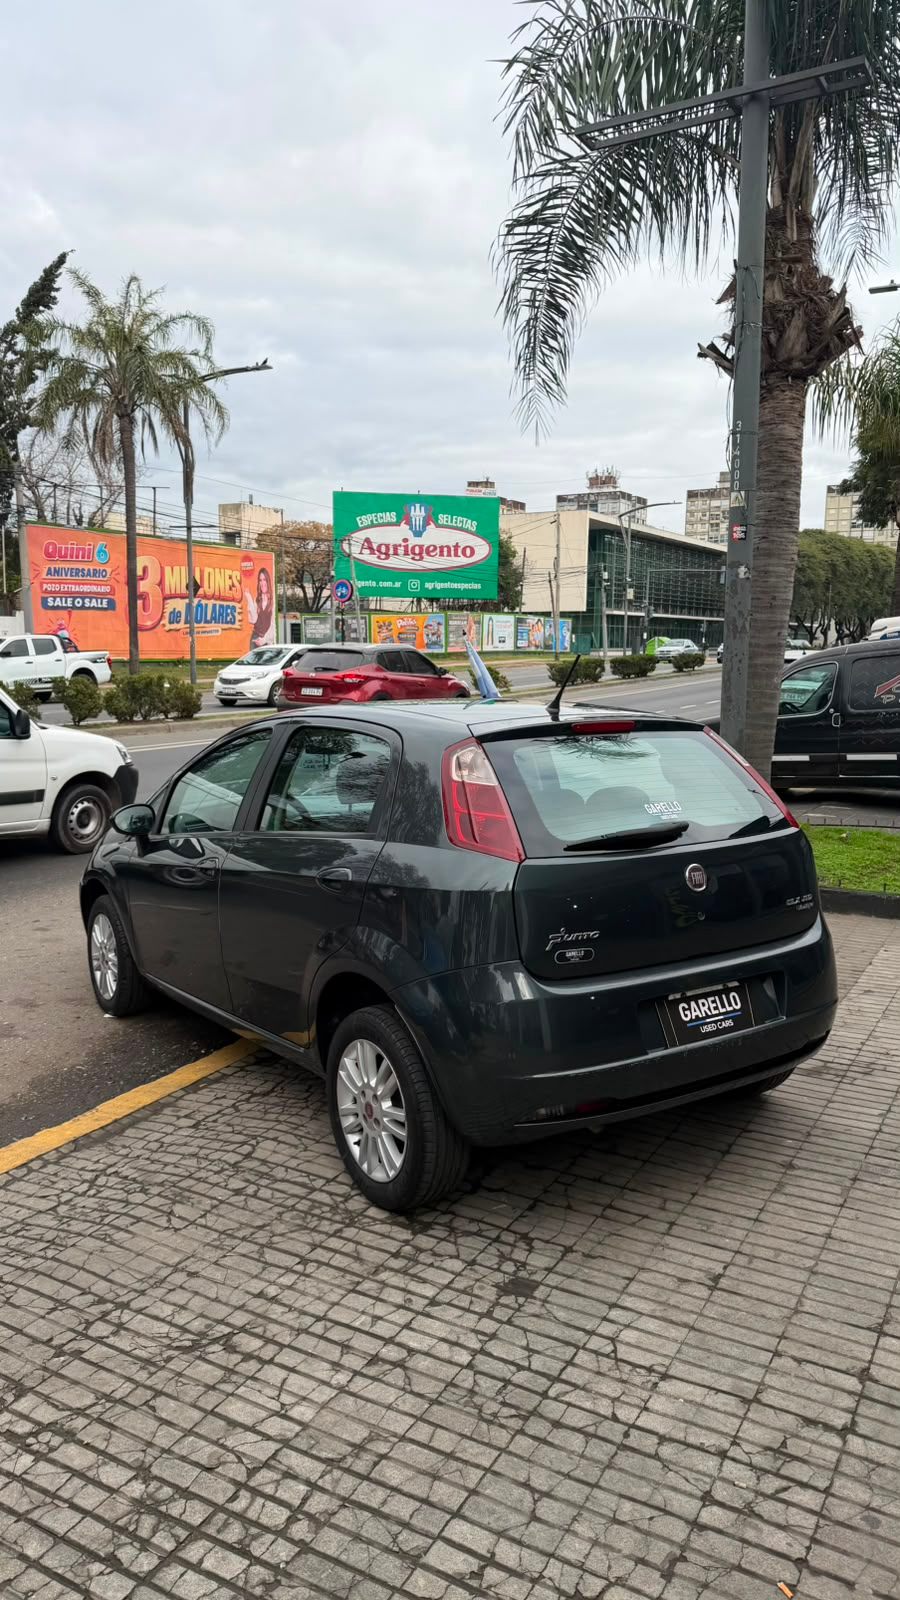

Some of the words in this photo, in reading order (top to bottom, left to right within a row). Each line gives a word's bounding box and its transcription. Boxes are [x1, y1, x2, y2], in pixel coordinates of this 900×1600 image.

[356, 512, 397, 527] ESPECIAS
[438, 514, 477, 531] SELECTAS
[43, 541, 93, 560] Quini
[96, 543, 109, 563] 6
[358, 537, 475, 561] Agrigento
[46, 566, 108, 578] ANIVERSARIO
[43, 583, 59, 592] POZO
[60, 584, 111, 593] EXTRAORDINARIO
[425, 581, 481, 590] agrigentoespecias
[127, 556, 163, 631] 3
[47, 597, 73, 607] SALE
[74, 598, 82, 607] O
[84, 598, 108, 608] SALE
[168, 608, 181, 624] de
[644, 801, 682, 814] GARELLO
[678, 991, 742, 1022] GARELLO
[700, 1023, 717, 1033] USED
[717, 1019, 734, 1029] CARS
